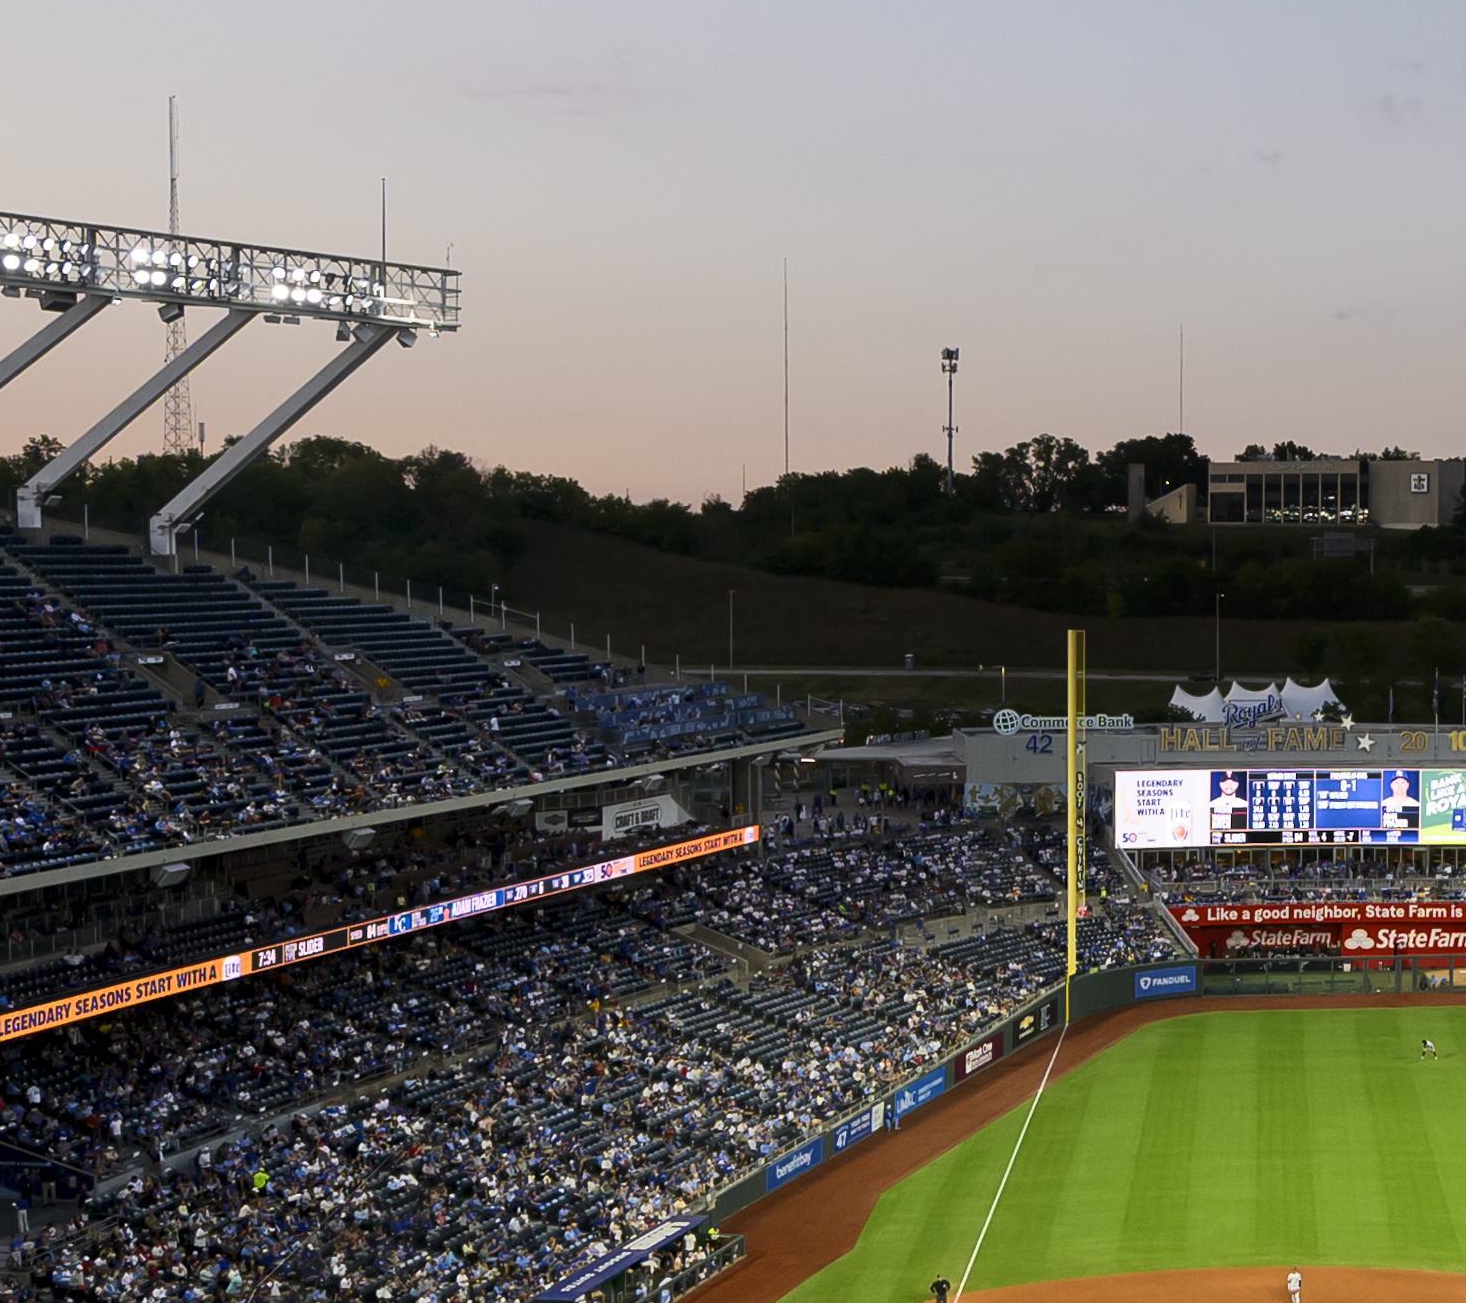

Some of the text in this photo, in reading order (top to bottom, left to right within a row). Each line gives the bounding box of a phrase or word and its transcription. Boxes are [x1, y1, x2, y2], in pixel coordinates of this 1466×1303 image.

[1223, 694, 1282, 728] Royals
[1098, 715, 1133, 728] Bank
[1026, 735, 1052, 753] 42
[1161, 727, 1345, 754] HALL of FAME
[1401, 731, 1426, 751] 20
[1431, 773, 1462, 789] BANK
[1137, 789, 1173, 797] SEASONS
[639, 836, 737, 867] LEGENDARY SEASONS START WITH
[452, 893, 496, 917] ADAM FRAZIER
[1207, 908, 1237, 921] Like
[1242, 910, 1250, 919] a
[1255, 906, 1289, 922] good
[1294, 905, 1361, 921] neighbor,
[1366, 905, 1404, 918] State
[1409, 905, 1446, 917] Farm
[1451, 904, 1463, 917] is
[298, 937, 323, 957] SLIDER
[258, 949, 276, 967] 7:34
[75, 987, 131, 1015] SEASONS
[136, 976, 173, 999] START
[176, 968, 206, 988] WITH
[210, 965, 216, 979] A
[1153, 975, 1190, 987] FANDUEL
[837, 1131, 847, 1148] 47
[776, 1149, 813, 1179] benefitbay
